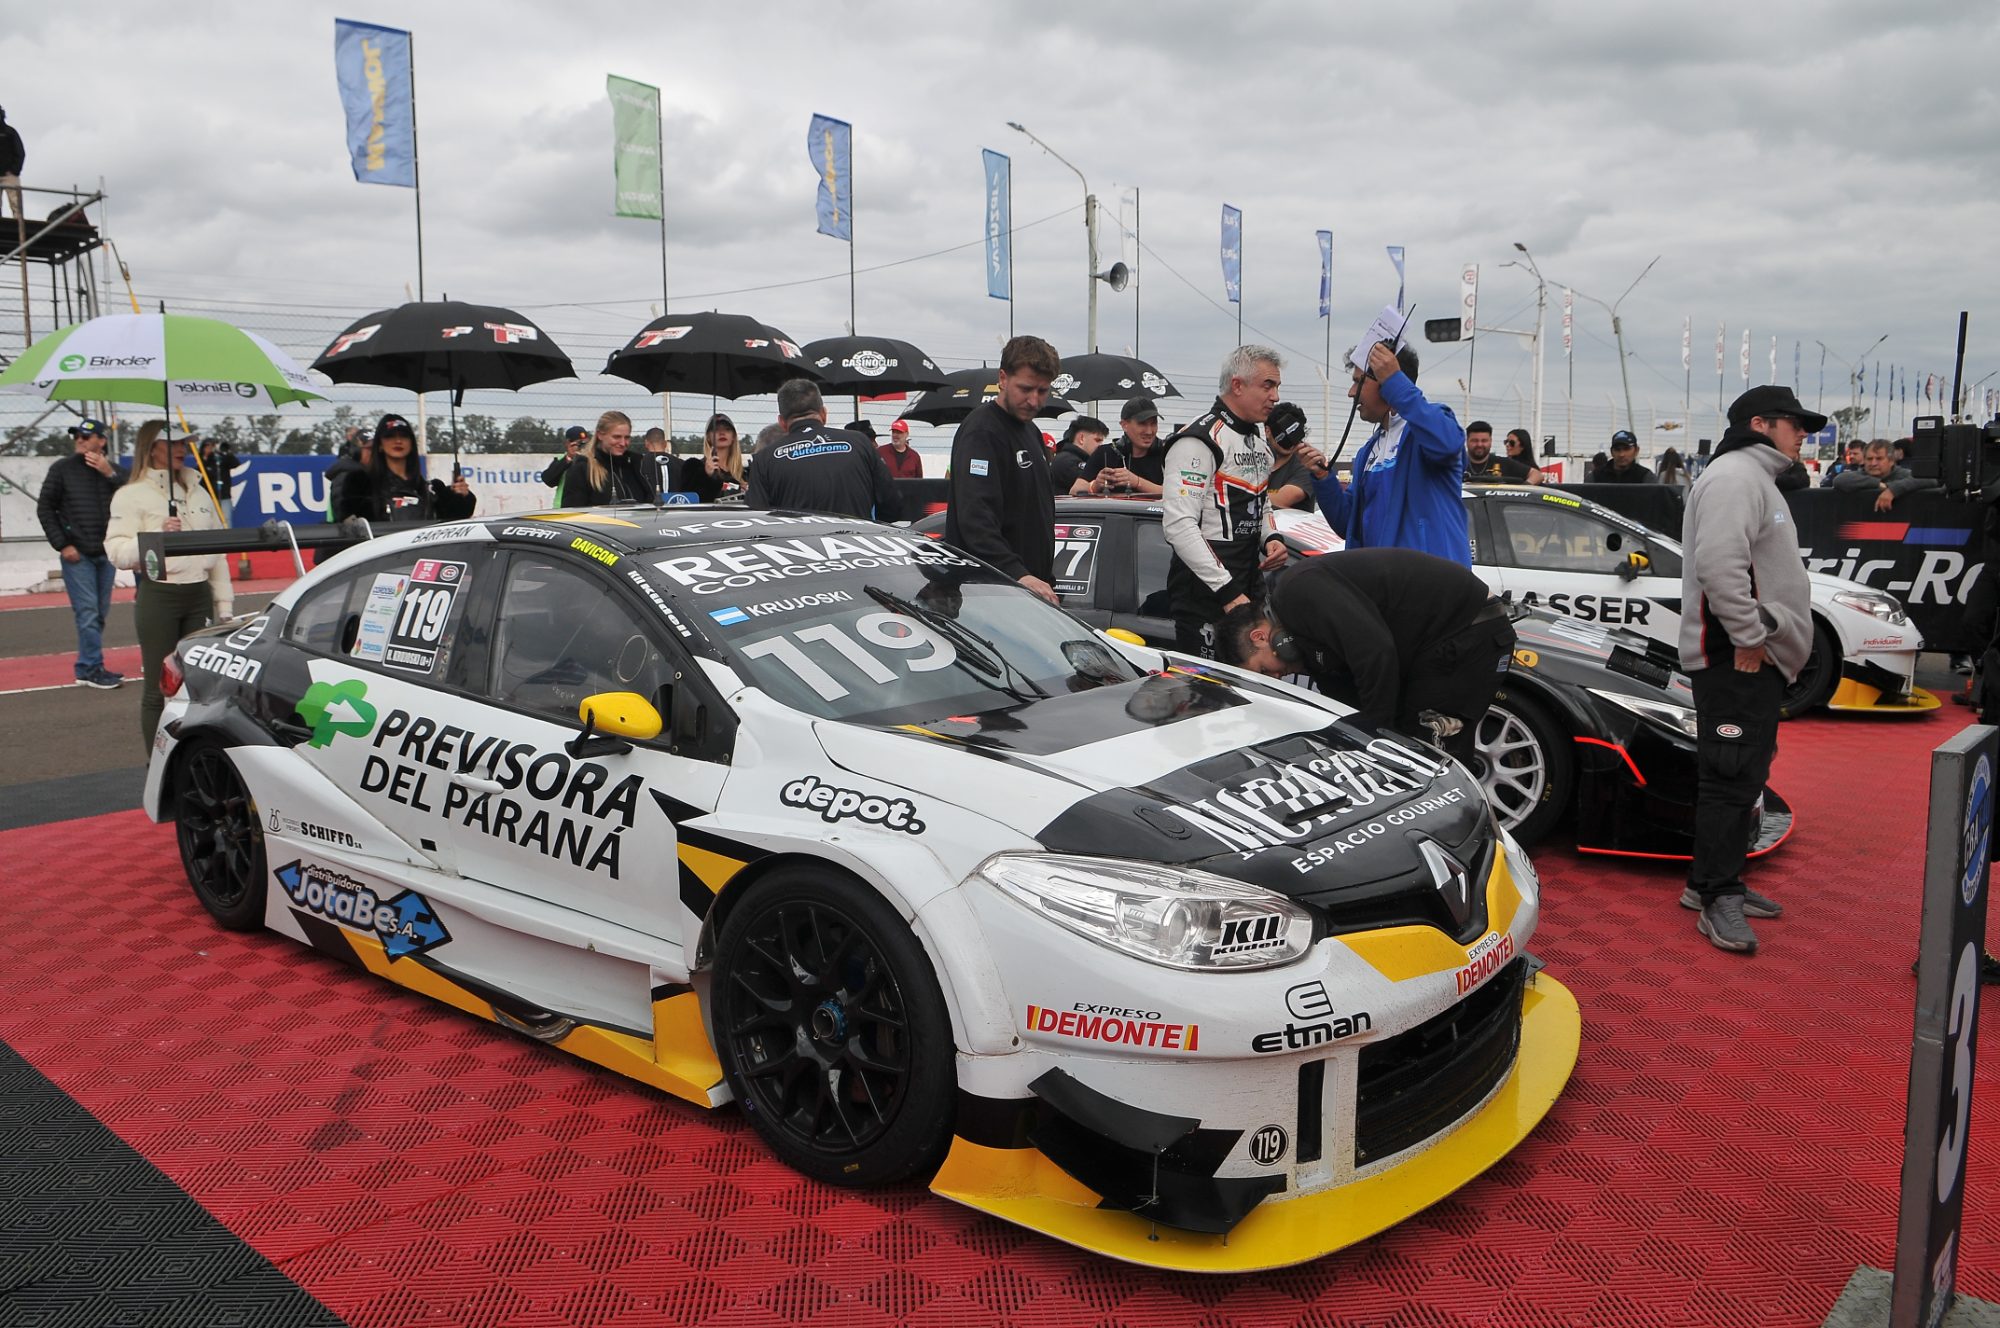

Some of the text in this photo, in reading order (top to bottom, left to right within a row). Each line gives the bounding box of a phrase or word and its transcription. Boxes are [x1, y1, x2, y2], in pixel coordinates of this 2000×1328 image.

[89, 355, 156, 368] Binder
[777, 442, 812, 456] Equipo
[258, 472, 331, 514] RU
[570, 537, 620, 567] DAVICOM
[653, 535, 960, 587] RENAULT
[691, 555, 982, 596] CONCESIONARIOS
[397, 587, 452, 642] 119
[745, 590, 854, 618] KRUJOSKI
[183, 643, 262, 684] etman
[740, 612, 957, 702] 119
[372, 708, 645, 828] PREVISORA
[301, 821, 354, 849] SCHIFFO
[360, 755, 626, 880] DEL PARANÁ
[1291, 787, 1468, 875] ESPACIO GOURMET
[306, 865, 363, 893] distribuidora
[293, 868, 397, 933] JotaBe
[1462, 937, 1510, 992] DEMONTE
[1468, 933, 1498, 959] EXPRESO
[1037, 1008, 1184, 1049] DEMONTE
[1073, 1002, 1162, 1020] EXPRESO
[1251, 1012, 1372, 1053] etman
[1937, 941, 1978, 1203] 3
[1256, 1130, 1281, 1161] 119
